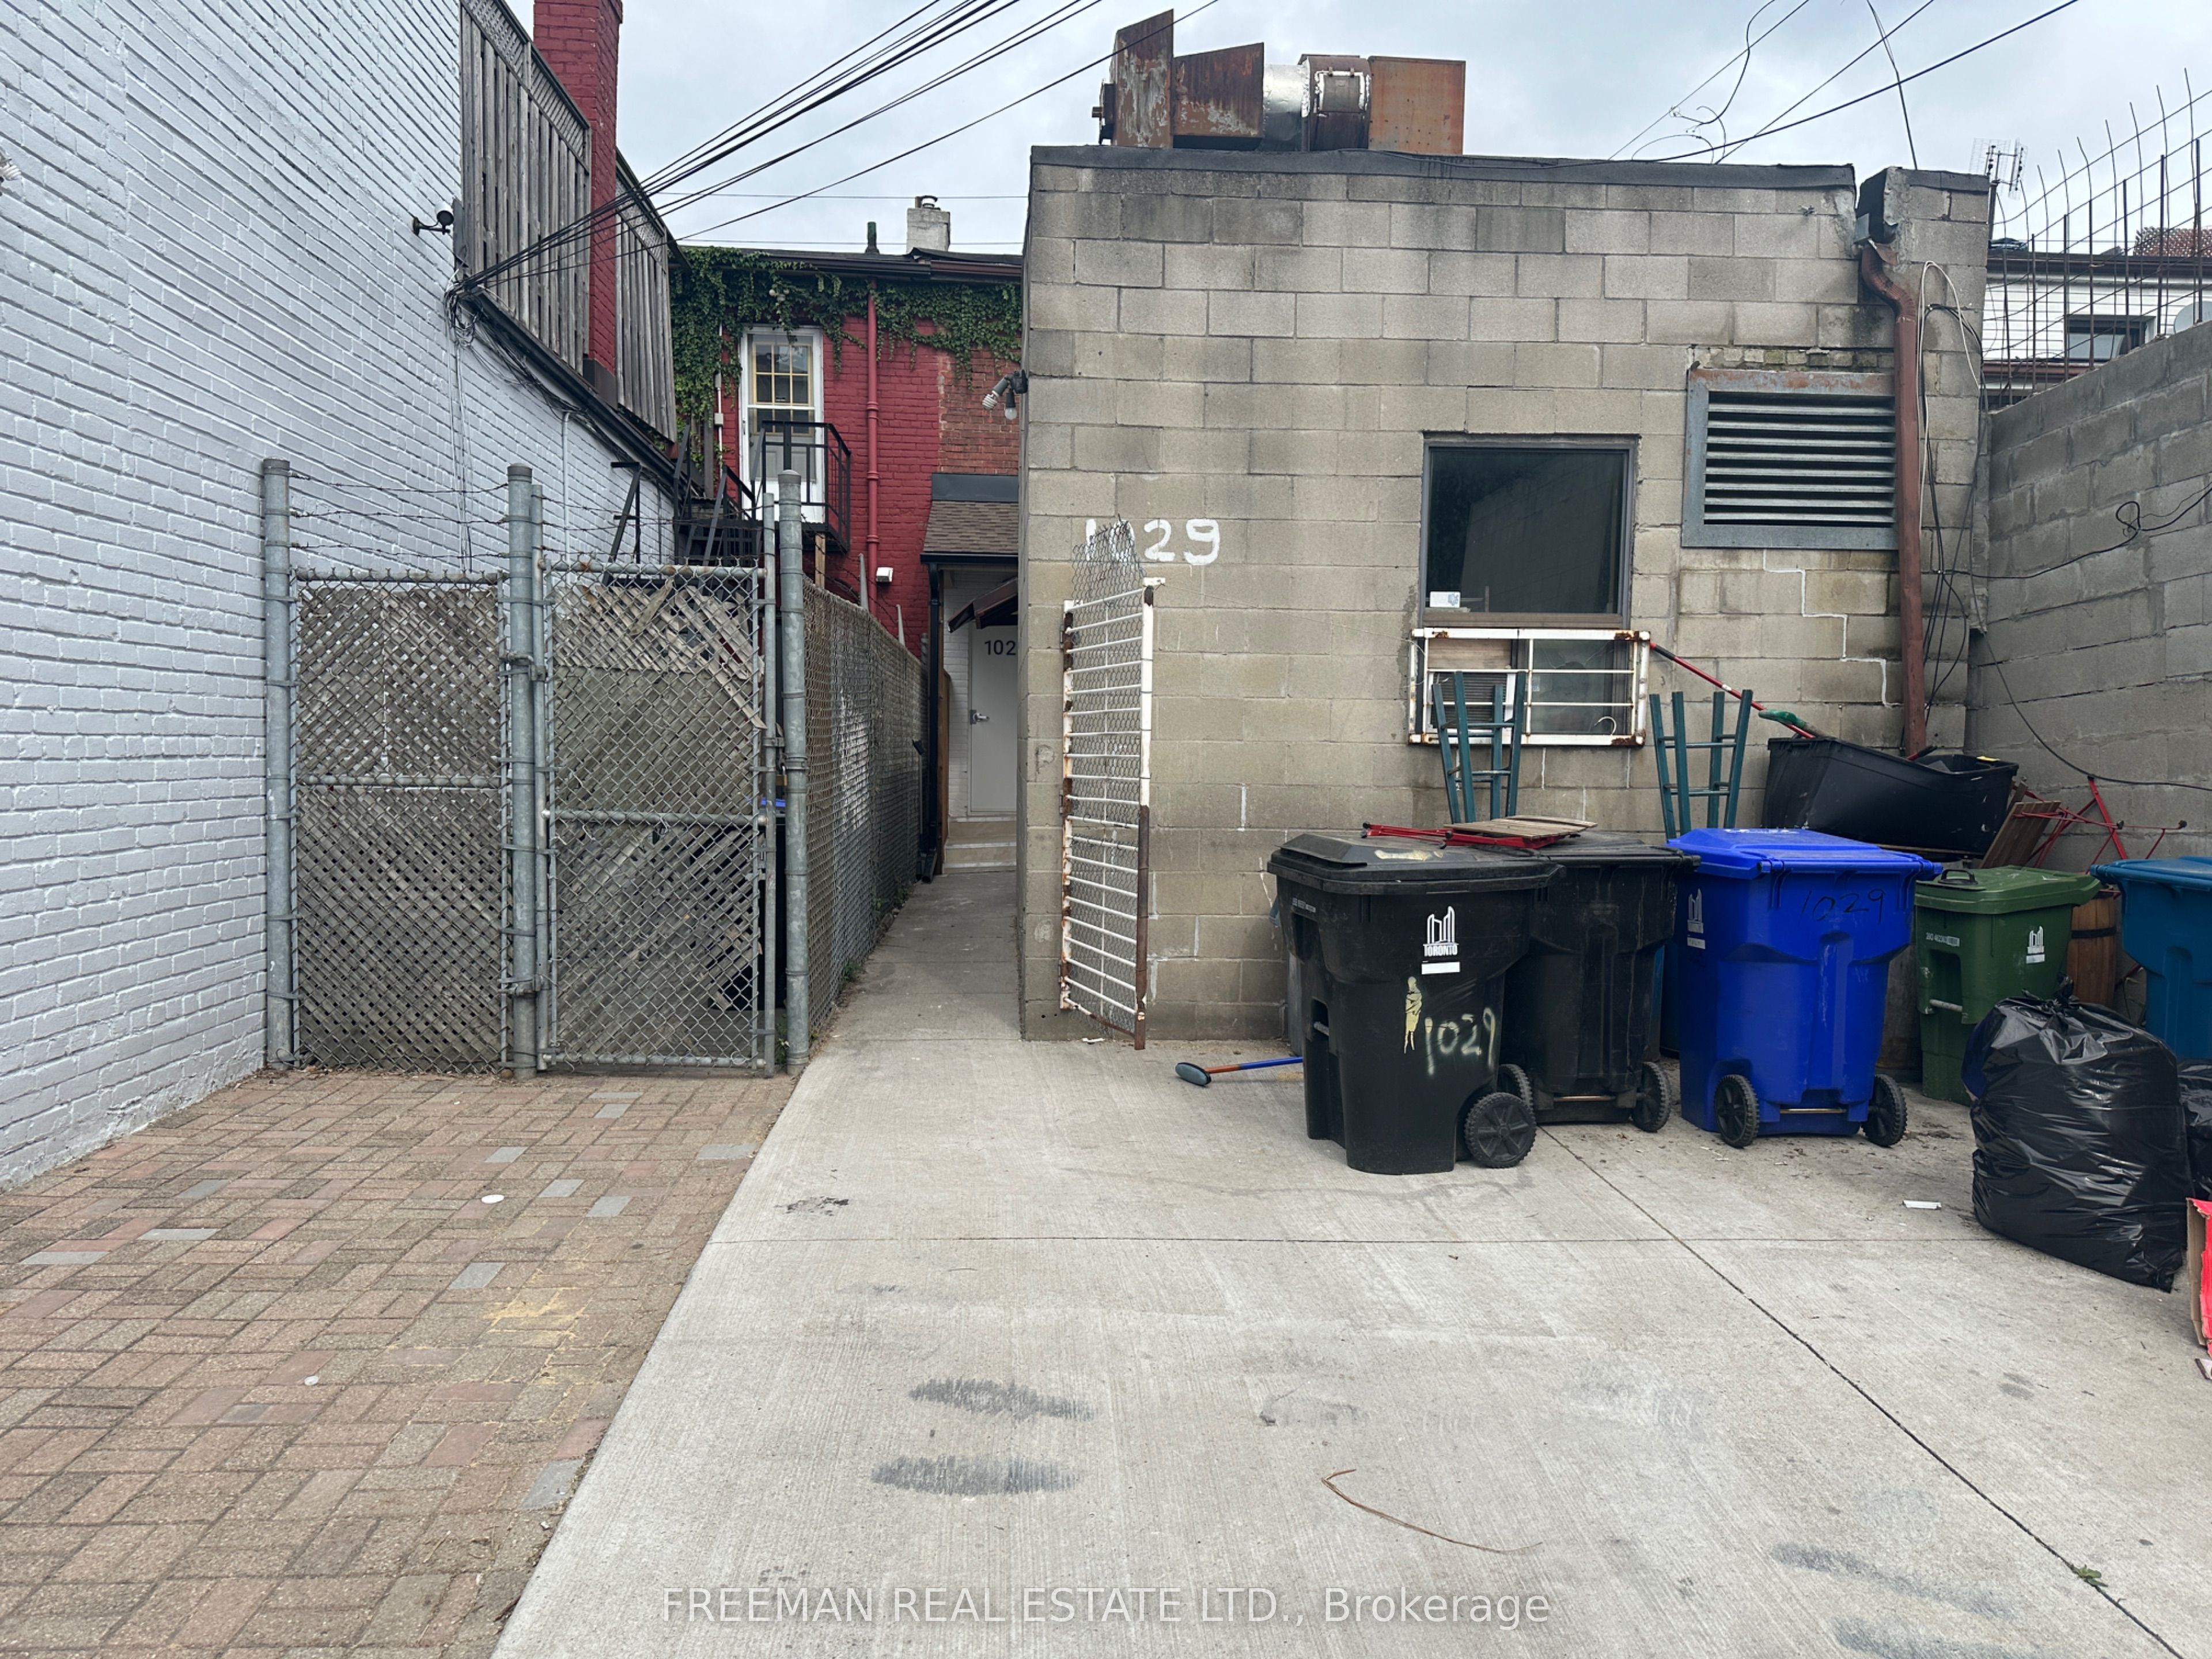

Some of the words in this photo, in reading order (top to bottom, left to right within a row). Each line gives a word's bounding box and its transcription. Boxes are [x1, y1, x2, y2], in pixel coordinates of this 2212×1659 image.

[1800, 888, 1885, 925] 1029
[1423, 943, 1459, 957] TORONTO
[1424, 1007, 1496, 1077] 1029
